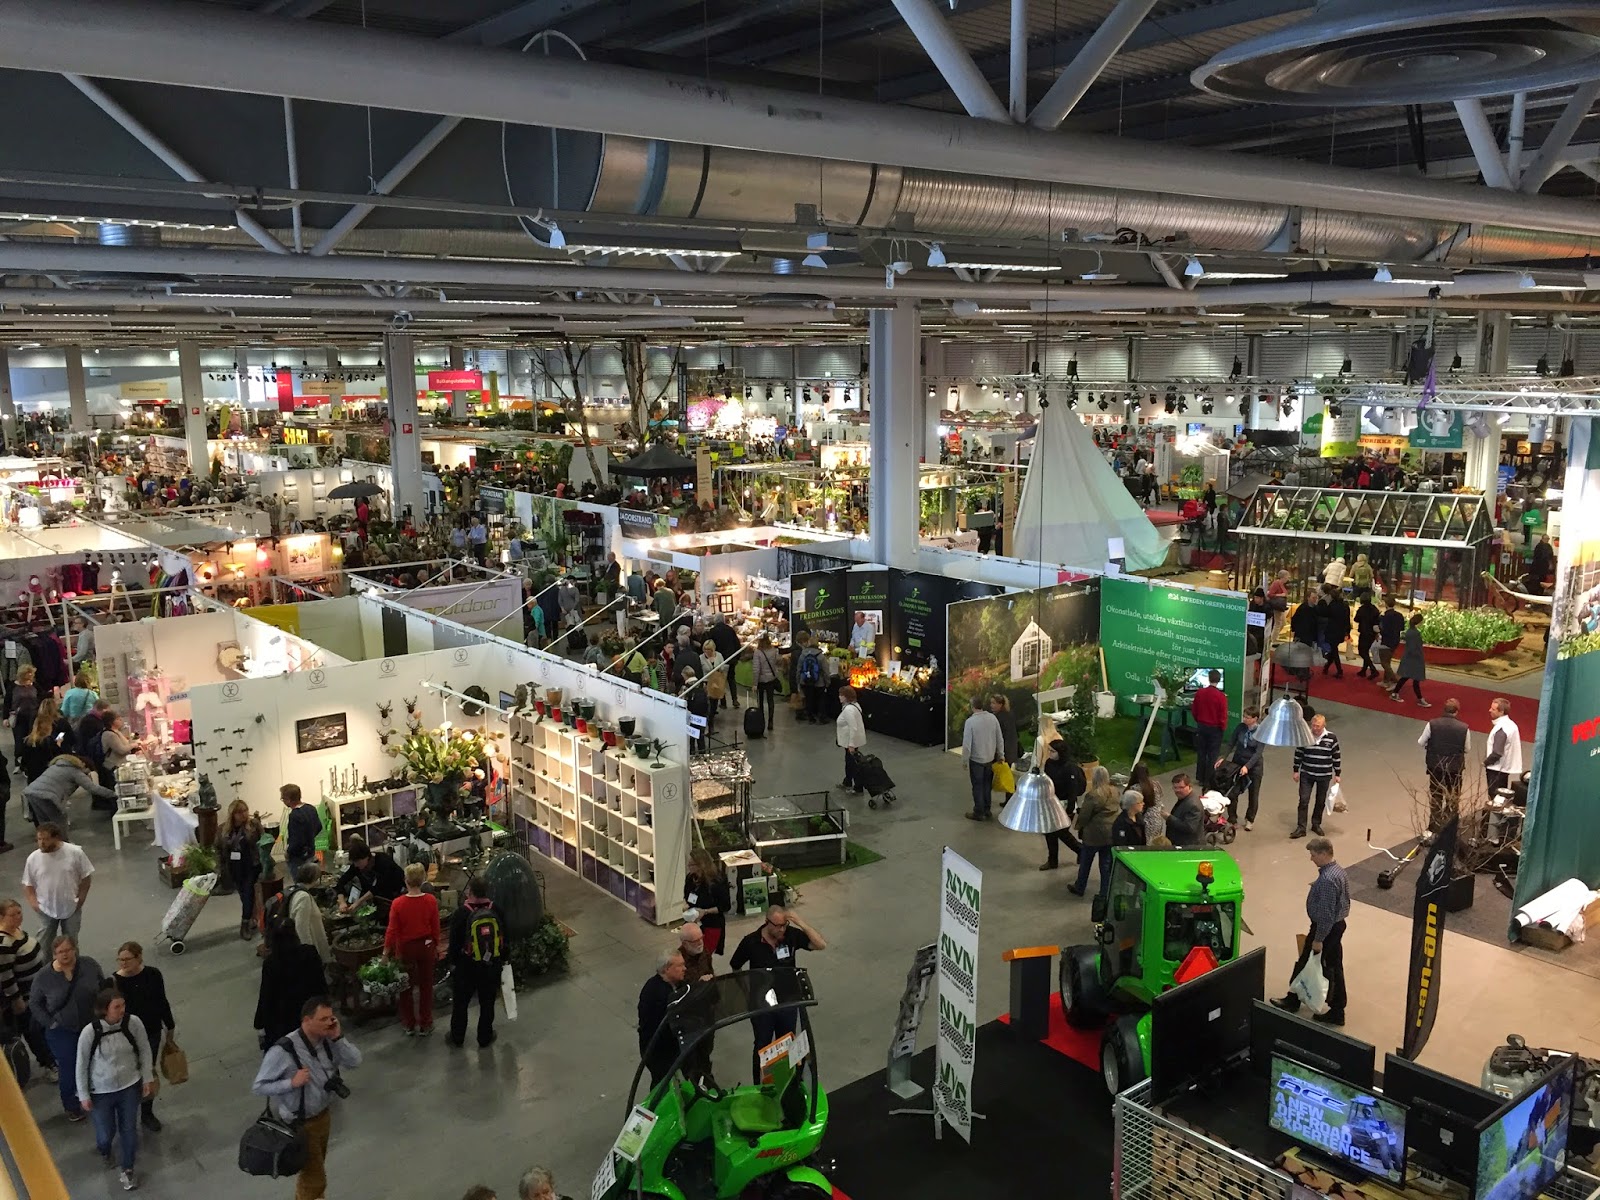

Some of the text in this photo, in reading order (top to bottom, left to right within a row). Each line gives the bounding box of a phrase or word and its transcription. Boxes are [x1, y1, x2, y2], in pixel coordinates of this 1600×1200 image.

[849, 593, 887, 601] FREDRIKSSONS
[1180, 594, 1246, 612] SWEDEN GREEN HOUSE
[800, 606, 845, 621] FREDRIKSSONS
[1137, 624, 1174, 639] Individuellt
[1175, 633, 1212, 647] anpassade
[1142, 613, 1167, 624] utsökta
[1166, 617, 1193, 629] växthus
[1194, 622, 1207, 632] och
[1208, 625, 1246, 638] orangerier
[1155, 649, 1171, 660] efter
[1172, 653, 1200, 666] gammal
[1171, 642, 1241, 664] för just din trädgård
[1125, 671, 1140, 682] Odla
[1274, 1091, 1324, 1121] A NEW
[1277, 1103, 1353, 1146] OFF-ROAD
